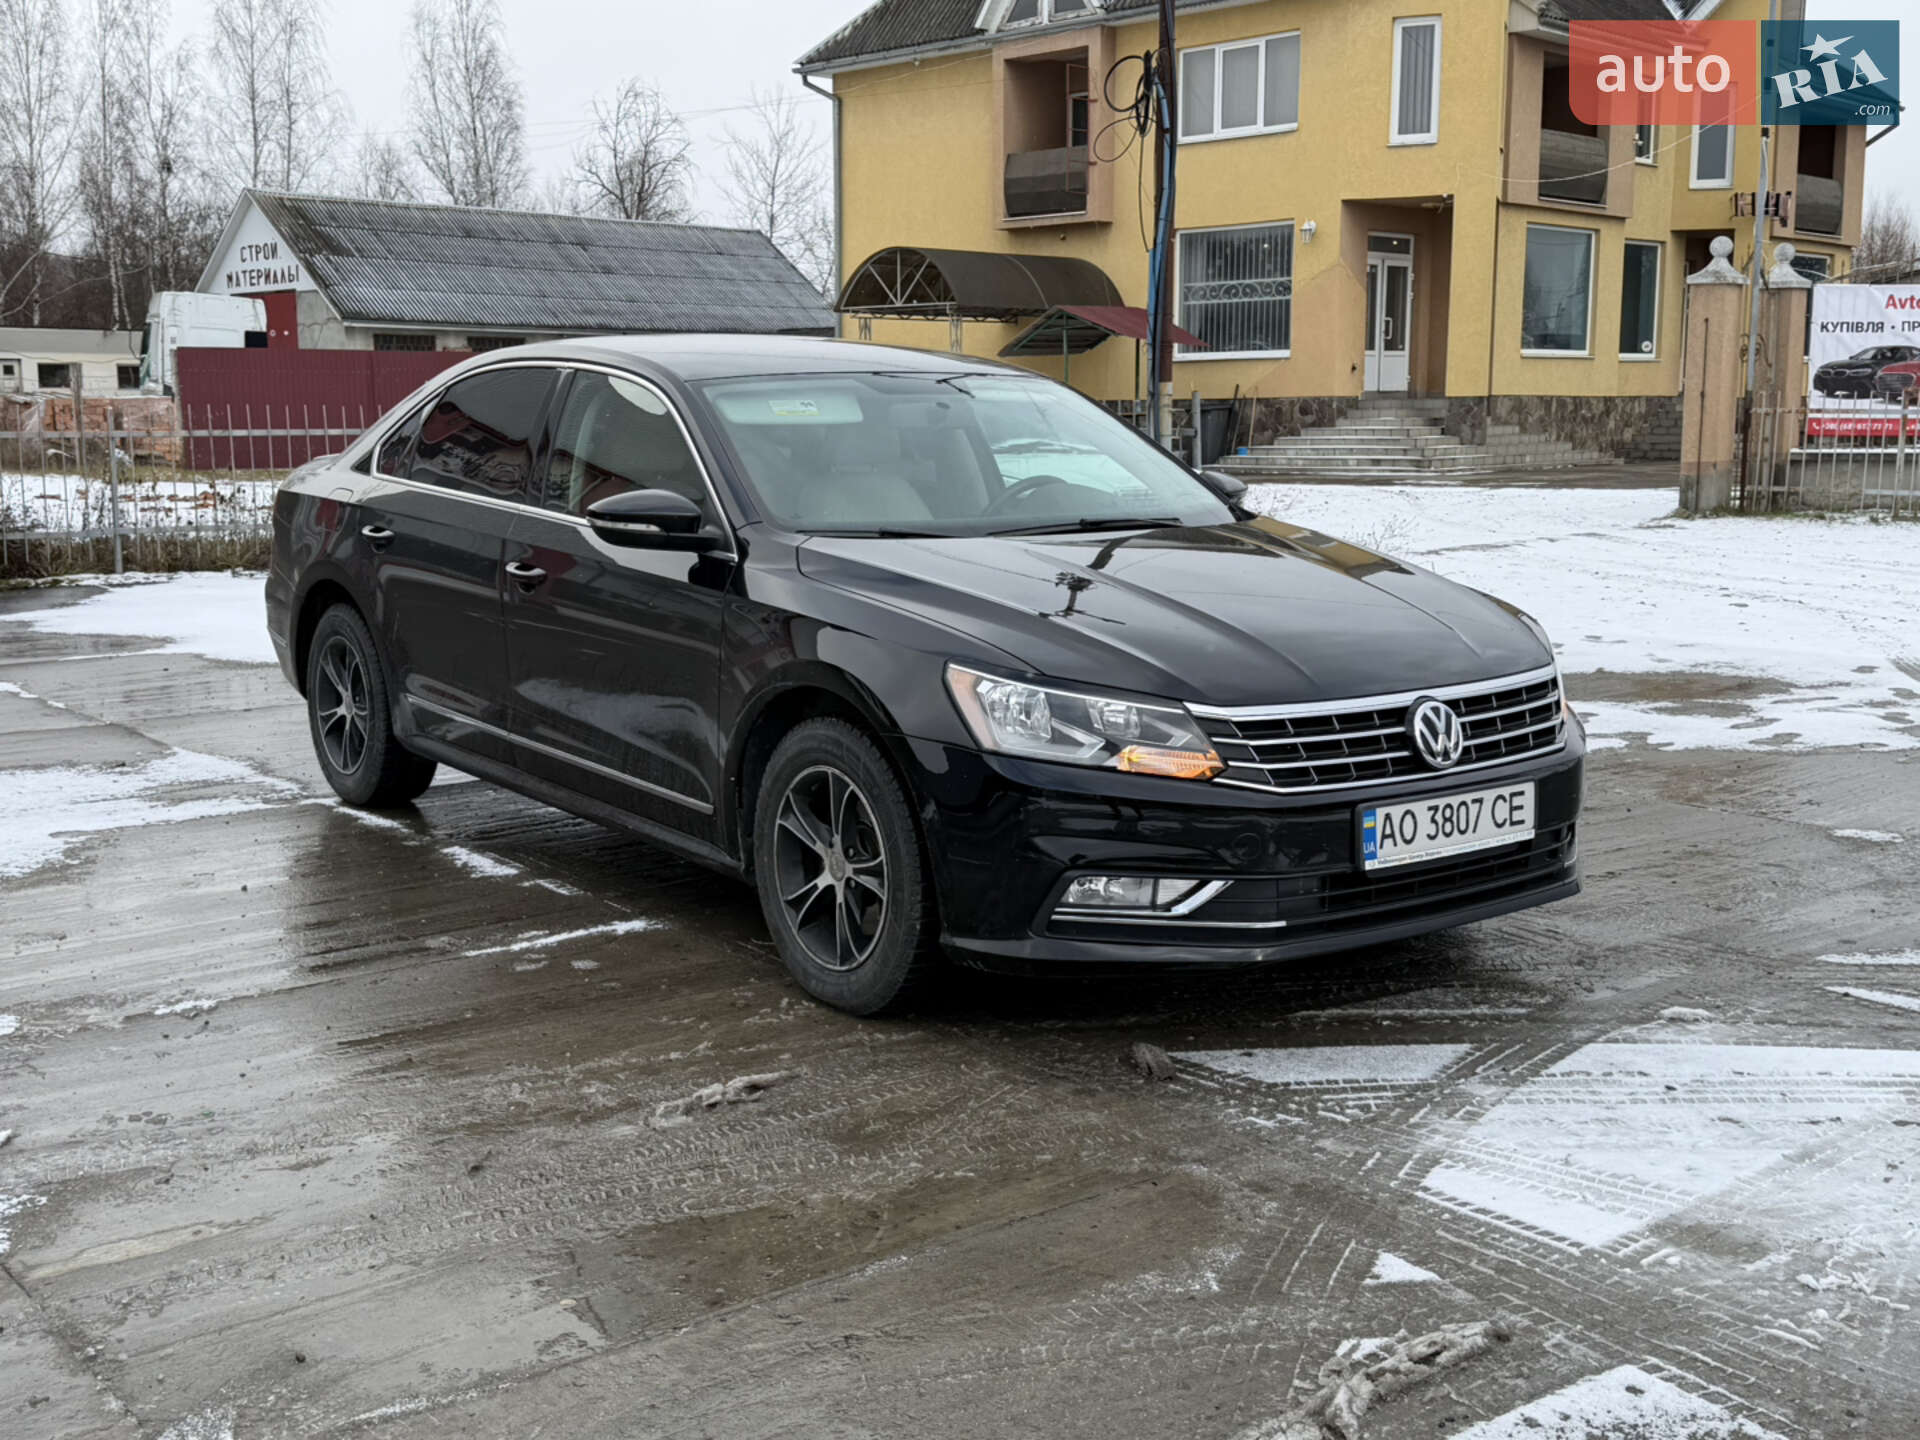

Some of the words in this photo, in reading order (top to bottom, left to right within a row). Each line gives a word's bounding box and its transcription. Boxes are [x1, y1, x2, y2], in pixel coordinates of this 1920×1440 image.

[226, 264, 300, 289] МАТЕРИАЛЫ
[1820, 321, 1885, 333] КУПІВЛЯ
[1379, 808, 1418, 850] AO
[1426, 797, 1485, 841] 3807
[1491, 790, 1526, 829] CE
[1363, 842, 1377, 854] UA
